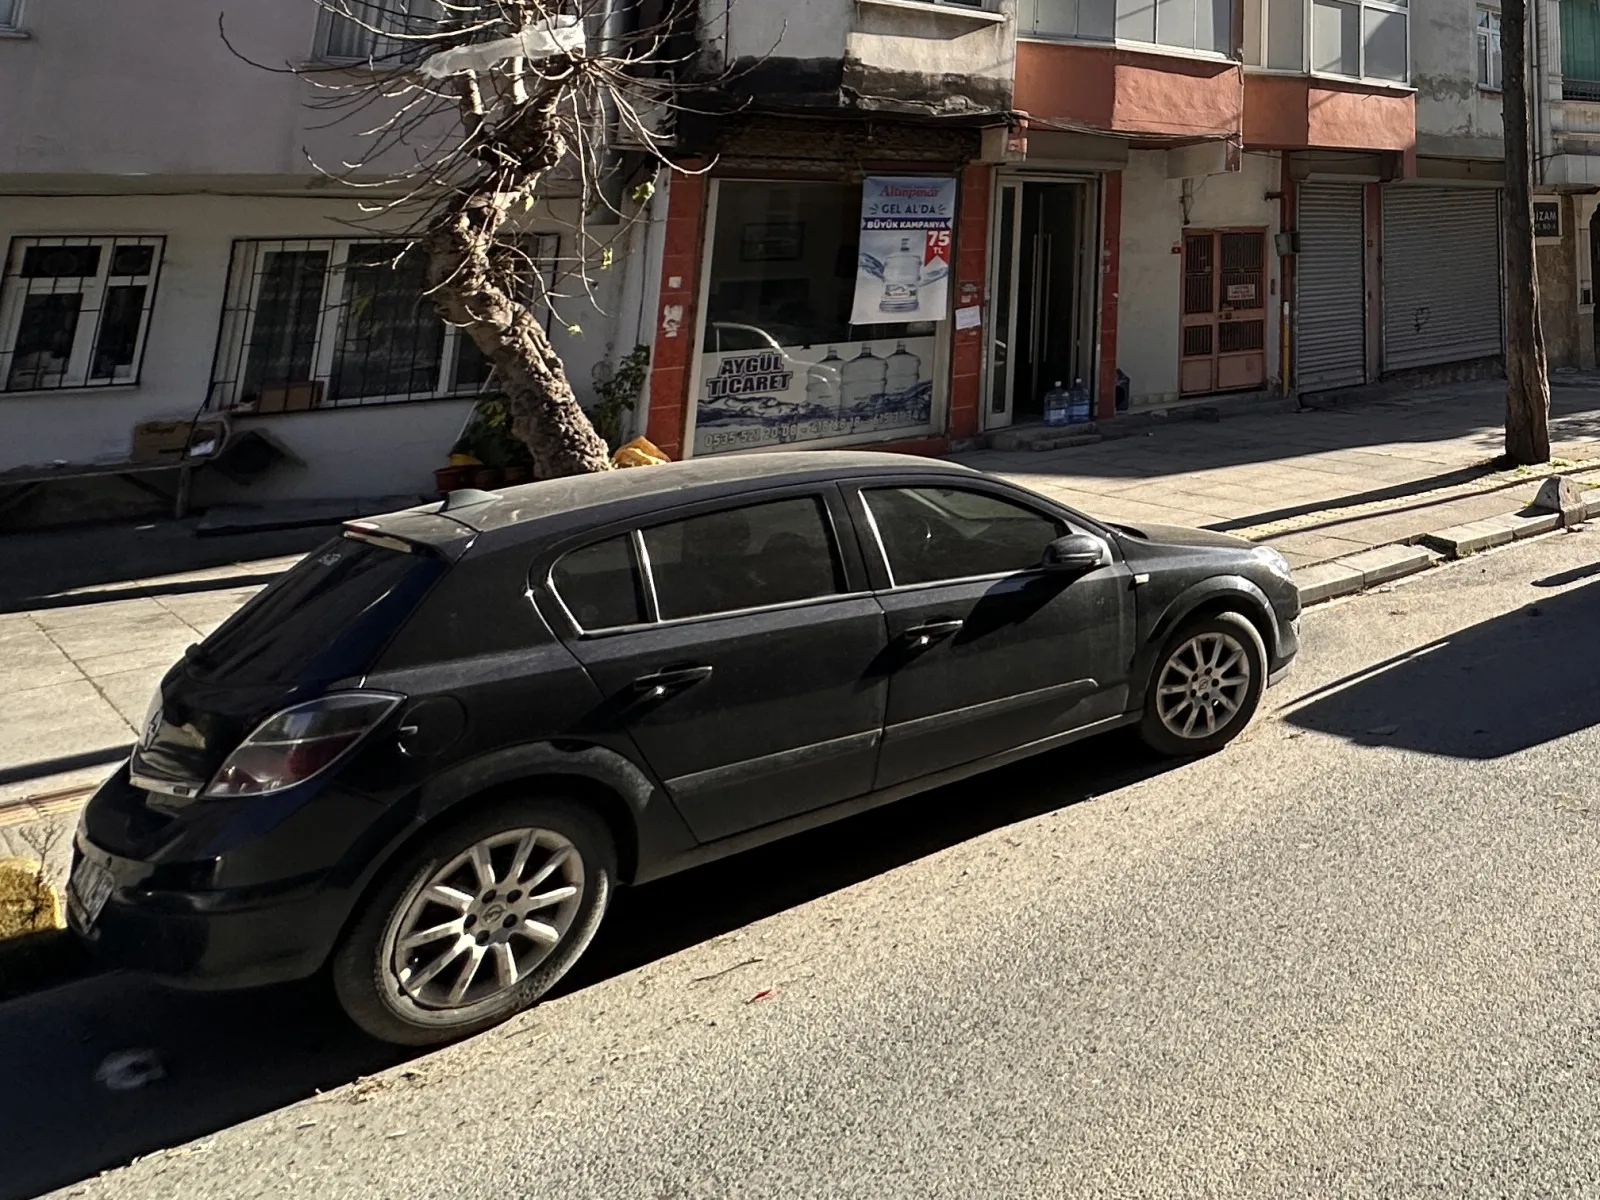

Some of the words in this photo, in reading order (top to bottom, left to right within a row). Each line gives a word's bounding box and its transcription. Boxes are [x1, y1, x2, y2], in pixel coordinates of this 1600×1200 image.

[881, 204, 902, 214] GEL
[905, 204, 936, 214] AL'DA
[867, 219, 898, 229] BÜYÜK
[899, 220, 946, 229] KAMPANYA
[928, 230, 950, 247] 75
[933, 247, 944, 255] TL
[720, 353, 783, 375] AYGÜL
[708, 373, 791, 396] TİCARET
[704, 432, 736, 448] 0535
